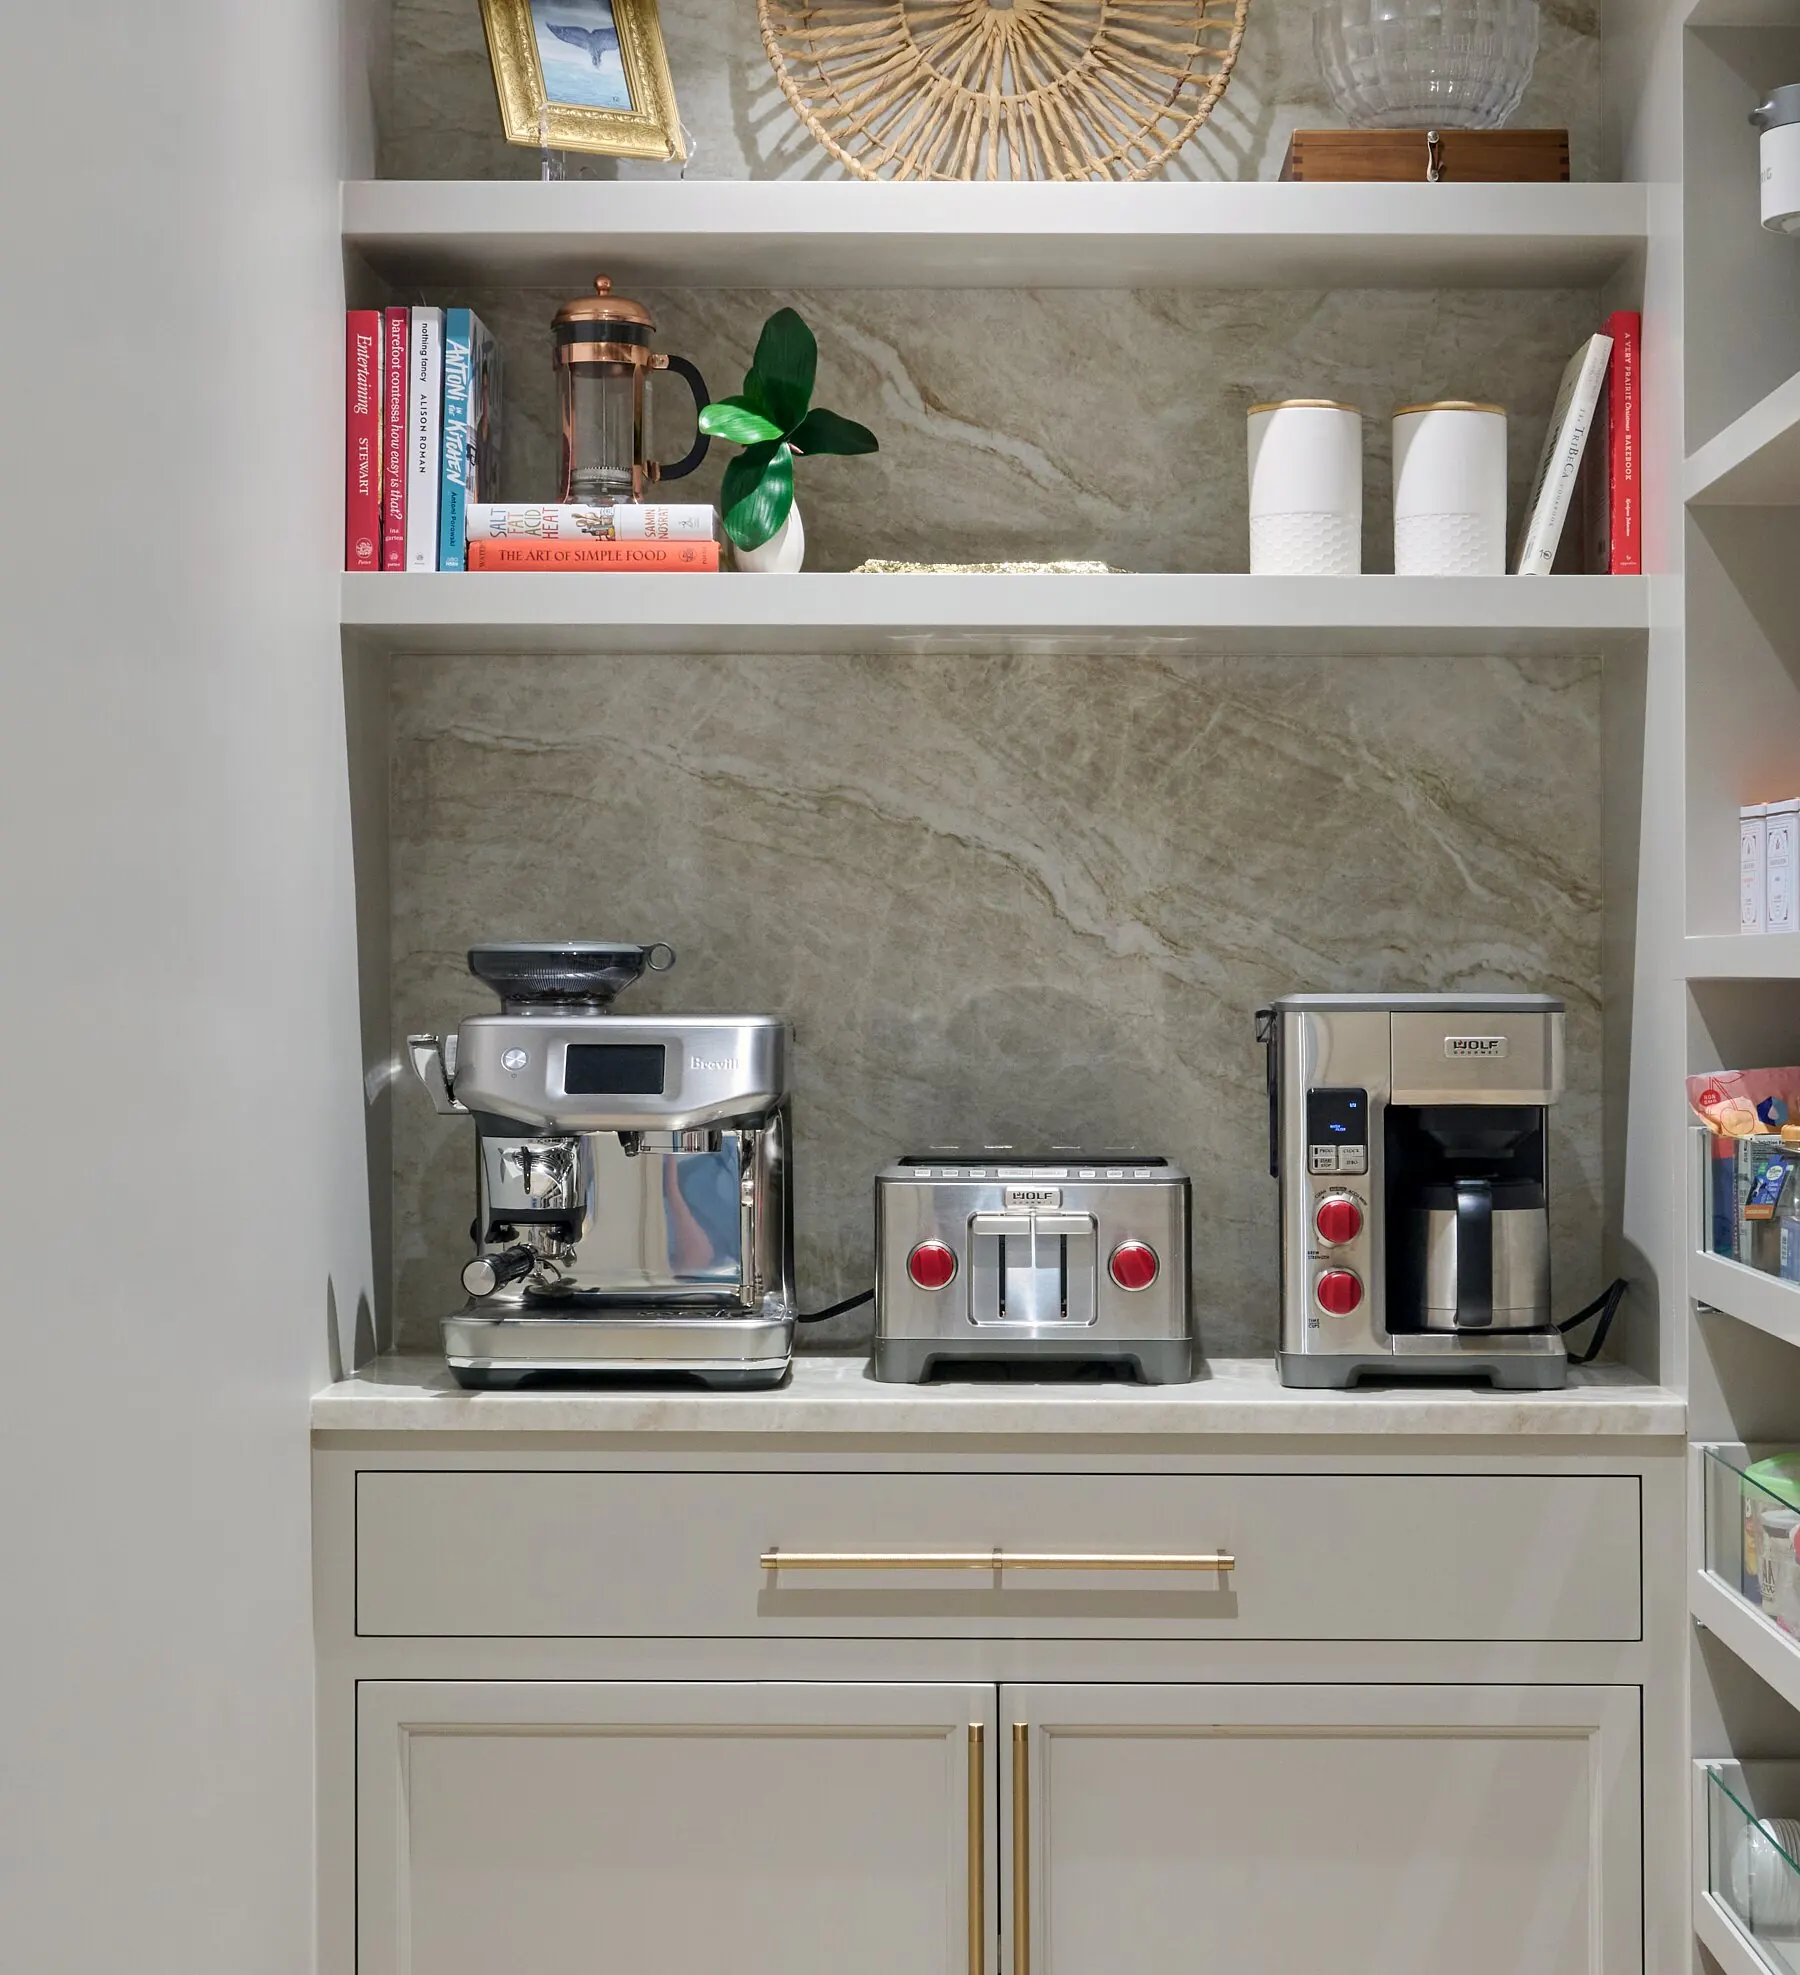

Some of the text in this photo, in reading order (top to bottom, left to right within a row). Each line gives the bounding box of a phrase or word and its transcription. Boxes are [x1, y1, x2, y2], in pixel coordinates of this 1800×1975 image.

[419, 323, 429, 382] nothing fancy
[1624, 341, 1632, 364] VERY
[354, 333, 372, 415] Entertaining
[391, 319, 404, 422] barefoot contessa
[1624, 366, 1632, 400] PRAIRIE
[1625, 402, 1633, 432] Christmas
[419, 394, 428, 473] ALISON ROMAN
[359, 437, 369, 496] STEWART
[386, 423, 403, 520] how easy is that?
[449, 491, 458, 515] Antoni
[449, 516, 457, 547] Porowski
[490, 508, 507, 538] SALT
[507, 512, 524, 534] FAT
[524, 508, 542, 537] ACID
[542, 507, 559, 540] HEAT
[645, 508, 656, 539] SAMIN
[658, 507, 669, 540] NOSRAT
[499, 549, 523, 562] THE
[527, 550, 552, 562] ART
[574, 550, 623, 562] SIMPLE
[626, 549, 667, 562] FOOD
[1453, 1040, 1499, 1050] WOLF
[690, 1055, 741, 1071] Brevill
[1013, 1192, 1053, 1200] WOLF
